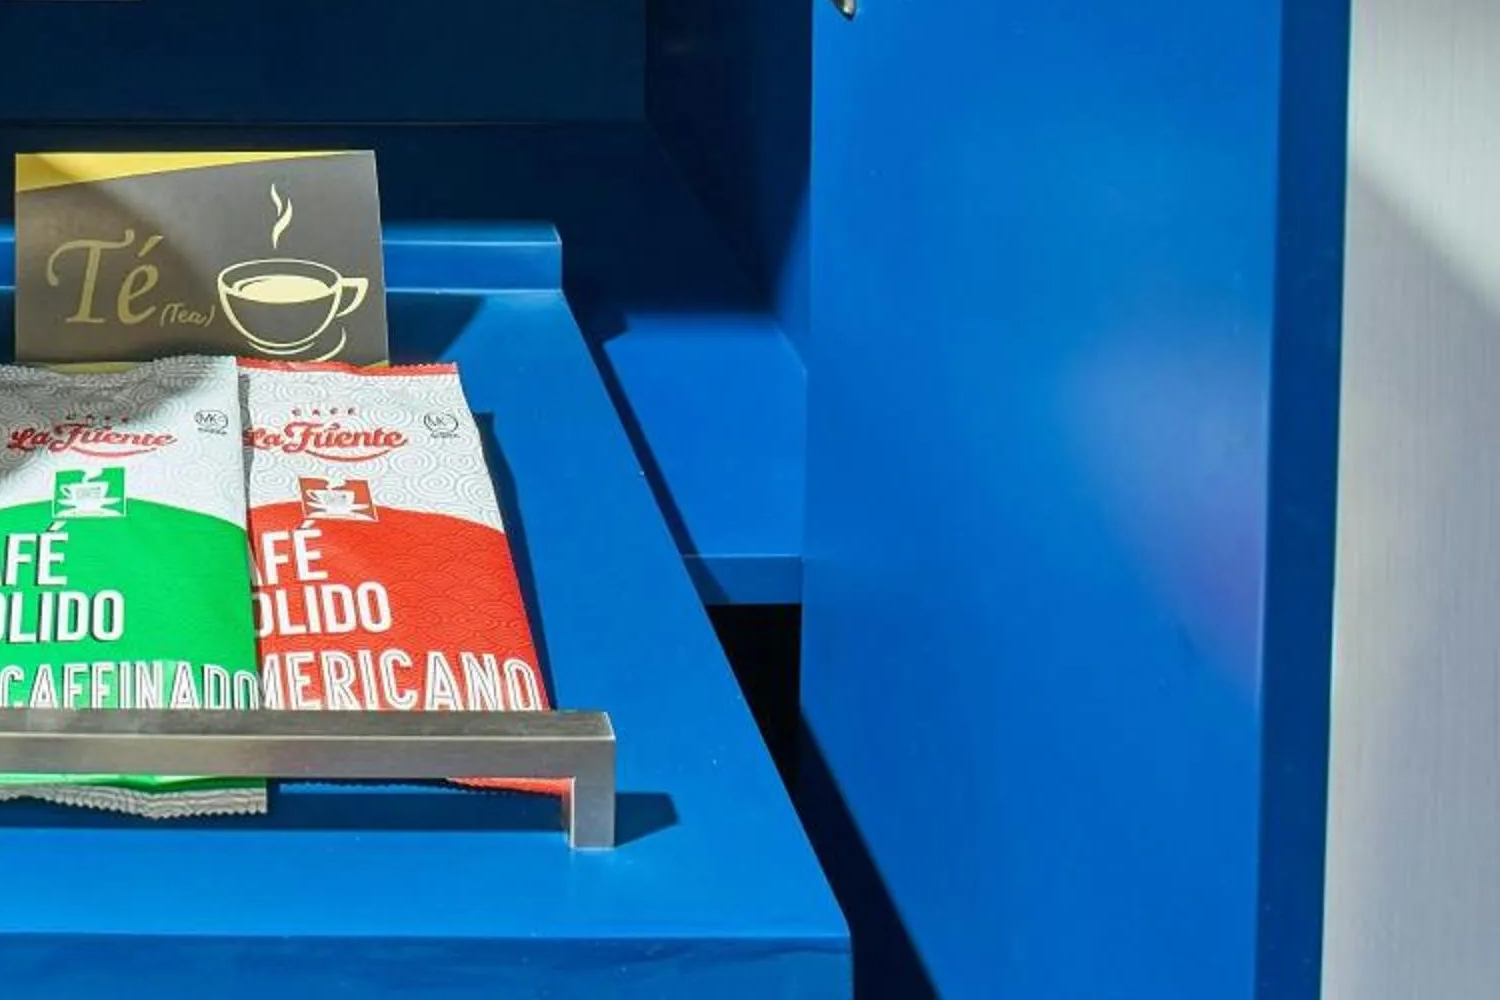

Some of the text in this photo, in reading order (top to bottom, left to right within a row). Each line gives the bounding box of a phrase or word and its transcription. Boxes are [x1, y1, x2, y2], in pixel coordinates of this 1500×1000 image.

[47, 229, 216, 328] Té (Tea)
[6, 423, 178, 457] La Fuente
[282, 420, 409, 461] Fuente
[256, 520, 329, 587] FÉ
[253, 581, 393, 639] OLIDO
[263, 649, 544, 711] MERICANO
